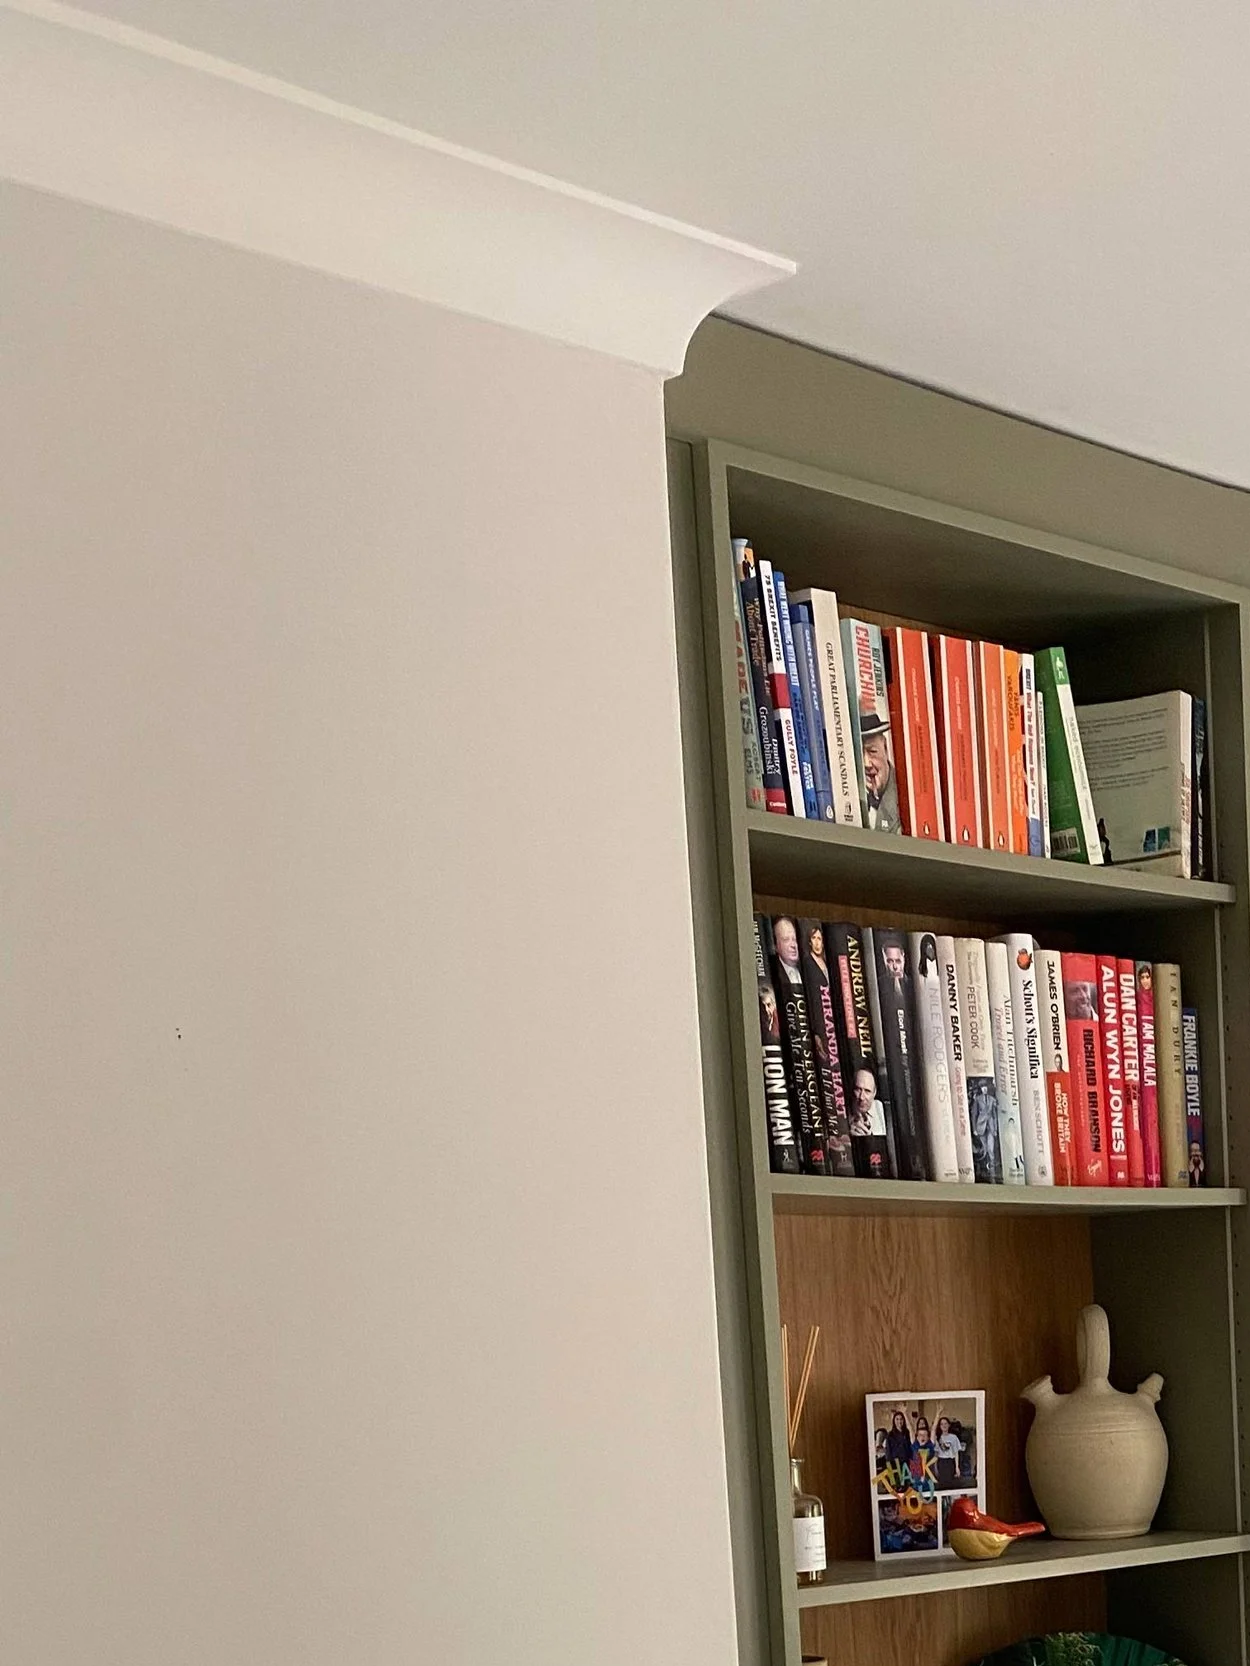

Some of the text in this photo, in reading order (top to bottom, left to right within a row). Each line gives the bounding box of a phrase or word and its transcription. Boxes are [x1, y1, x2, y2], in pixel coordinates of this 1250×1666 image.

[766, 588, 778, 619] BREXIT
[750, 637, 763, 666] Trade
[771, 620, 783, 661] BENEFITS
[759, 707, 775, 774] Grozoubinski
[784, 719, 798, 775] GULLY FOYLE
[825, 642, 850, 796] GREAT PARLIAMENTARY SCANDALS
[744, 748, 753, 774] ELMS
[771, 739, 782, 775] Dmitry
[846, 935, 872, 1058] ANDREW NEIL
[945, 964, 958, 1011] DANNY
[1022, 979, 1034, 1025] Schott's
[1047, 961, 1062, 1050] JAMES O'BRIEN
[1119, 973, 1136, 1010] DAN
[897, 1009, 906, 1027] Elon
[899, 1030, 909, 1055] Musk
[928, 987, 949, 1103] NILE RODGERS
[951, 1016, 963, 1061] BAKER
[967, 987, 980, 1049] PETER COOK
[1142, 1022, 1154, 1039] AM
[1170, 973, 1181, 1076] IAN DURY
[785, 1002, 812, 1133] Give Me Ten Seconds
[794, 992, 823, 1139] JOHN SERGEANT
[819, 985, 847, 1119] MIRANDA HART
[1025, 1027, 1040, 1079] Significa
[1101, 965, 1125, 1152] ALUN WYN JONES
[1123, 1013, 1139, 1081] CARTER
[1144, 1043, 1156, 1086] MALALA
[1182, 1015, 1200, 1116] FRANKIE BOYLE
[762, 1045, 794, 1145] LION MAN
[1054, 1082, 1067, 1152] BROKE BRITAIN
[1061, 1093, 1071, 1142] HOW THEY
[1083, 1029, 1101, 1152] RICHARD BRANSON
[1035, 1113, 1045, 1154] SCHOTT
